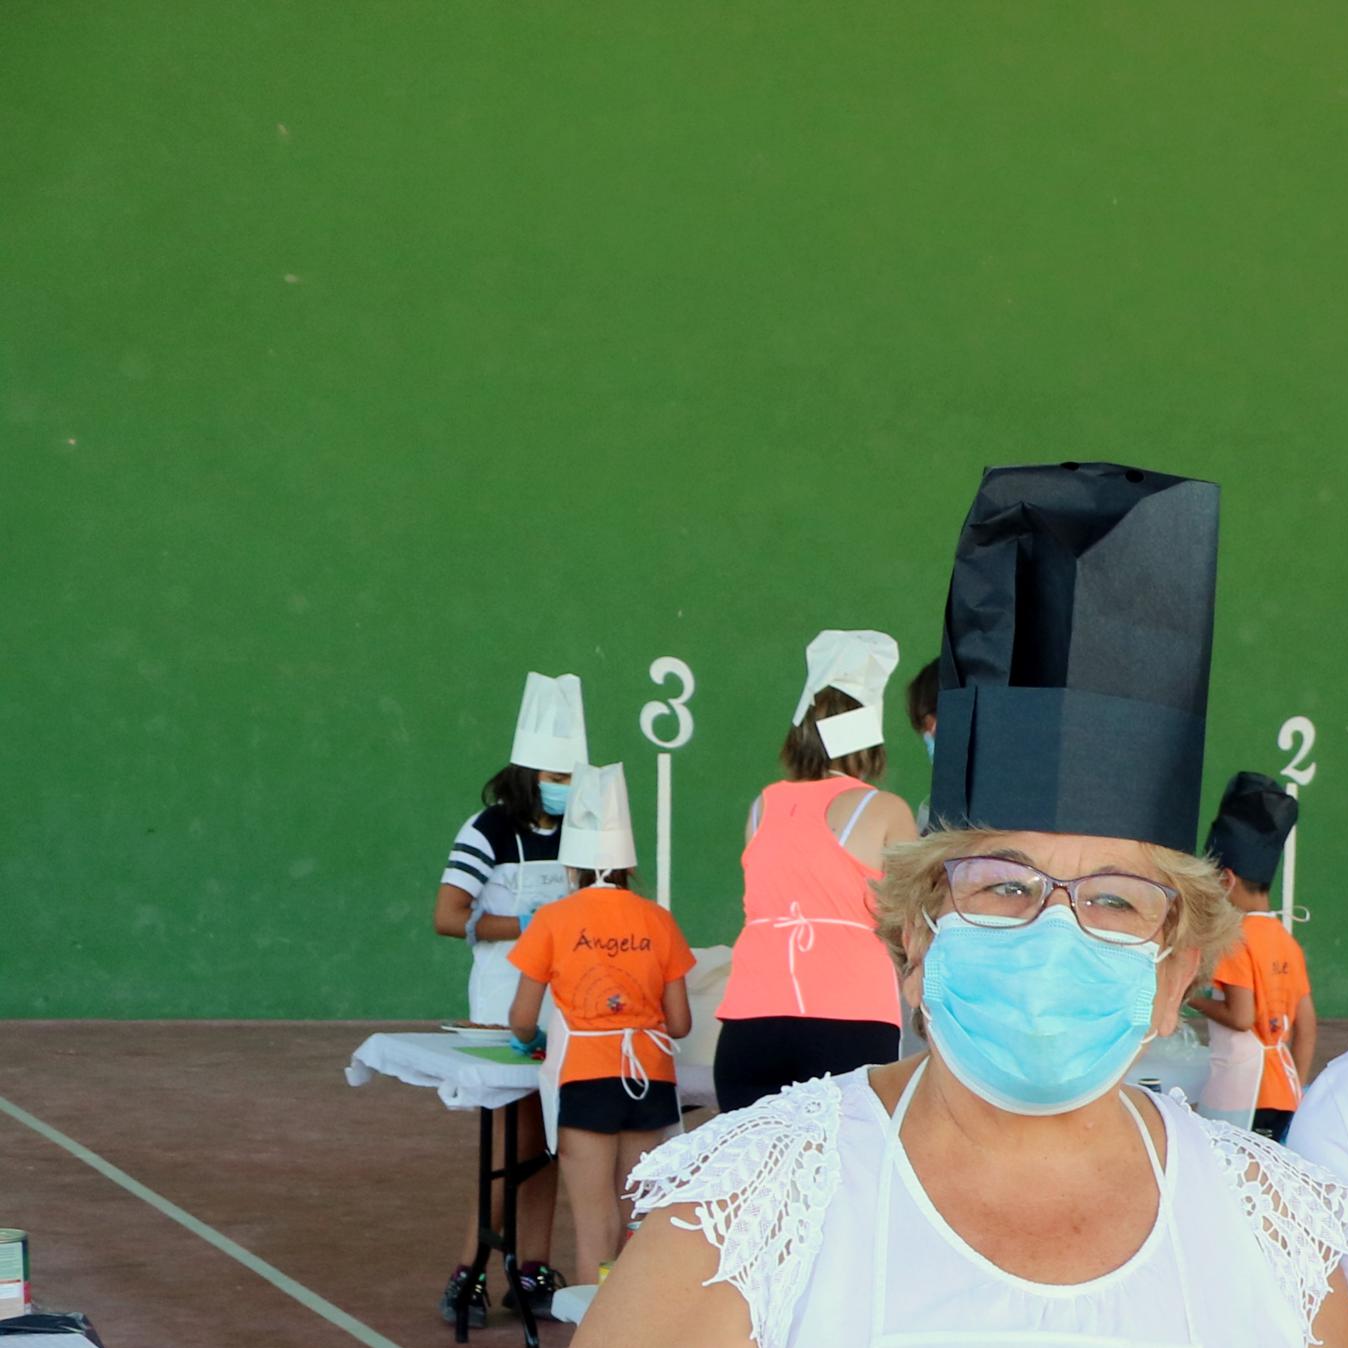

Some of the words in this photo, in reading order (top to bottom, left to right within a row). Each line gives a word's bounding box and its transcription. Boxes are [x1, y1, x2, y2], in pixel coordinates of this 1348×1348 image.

[640, 656, 695, 749] 3
[1277, 716, 1317, 786] 2
[572, 928, 652, 958] Ángela
